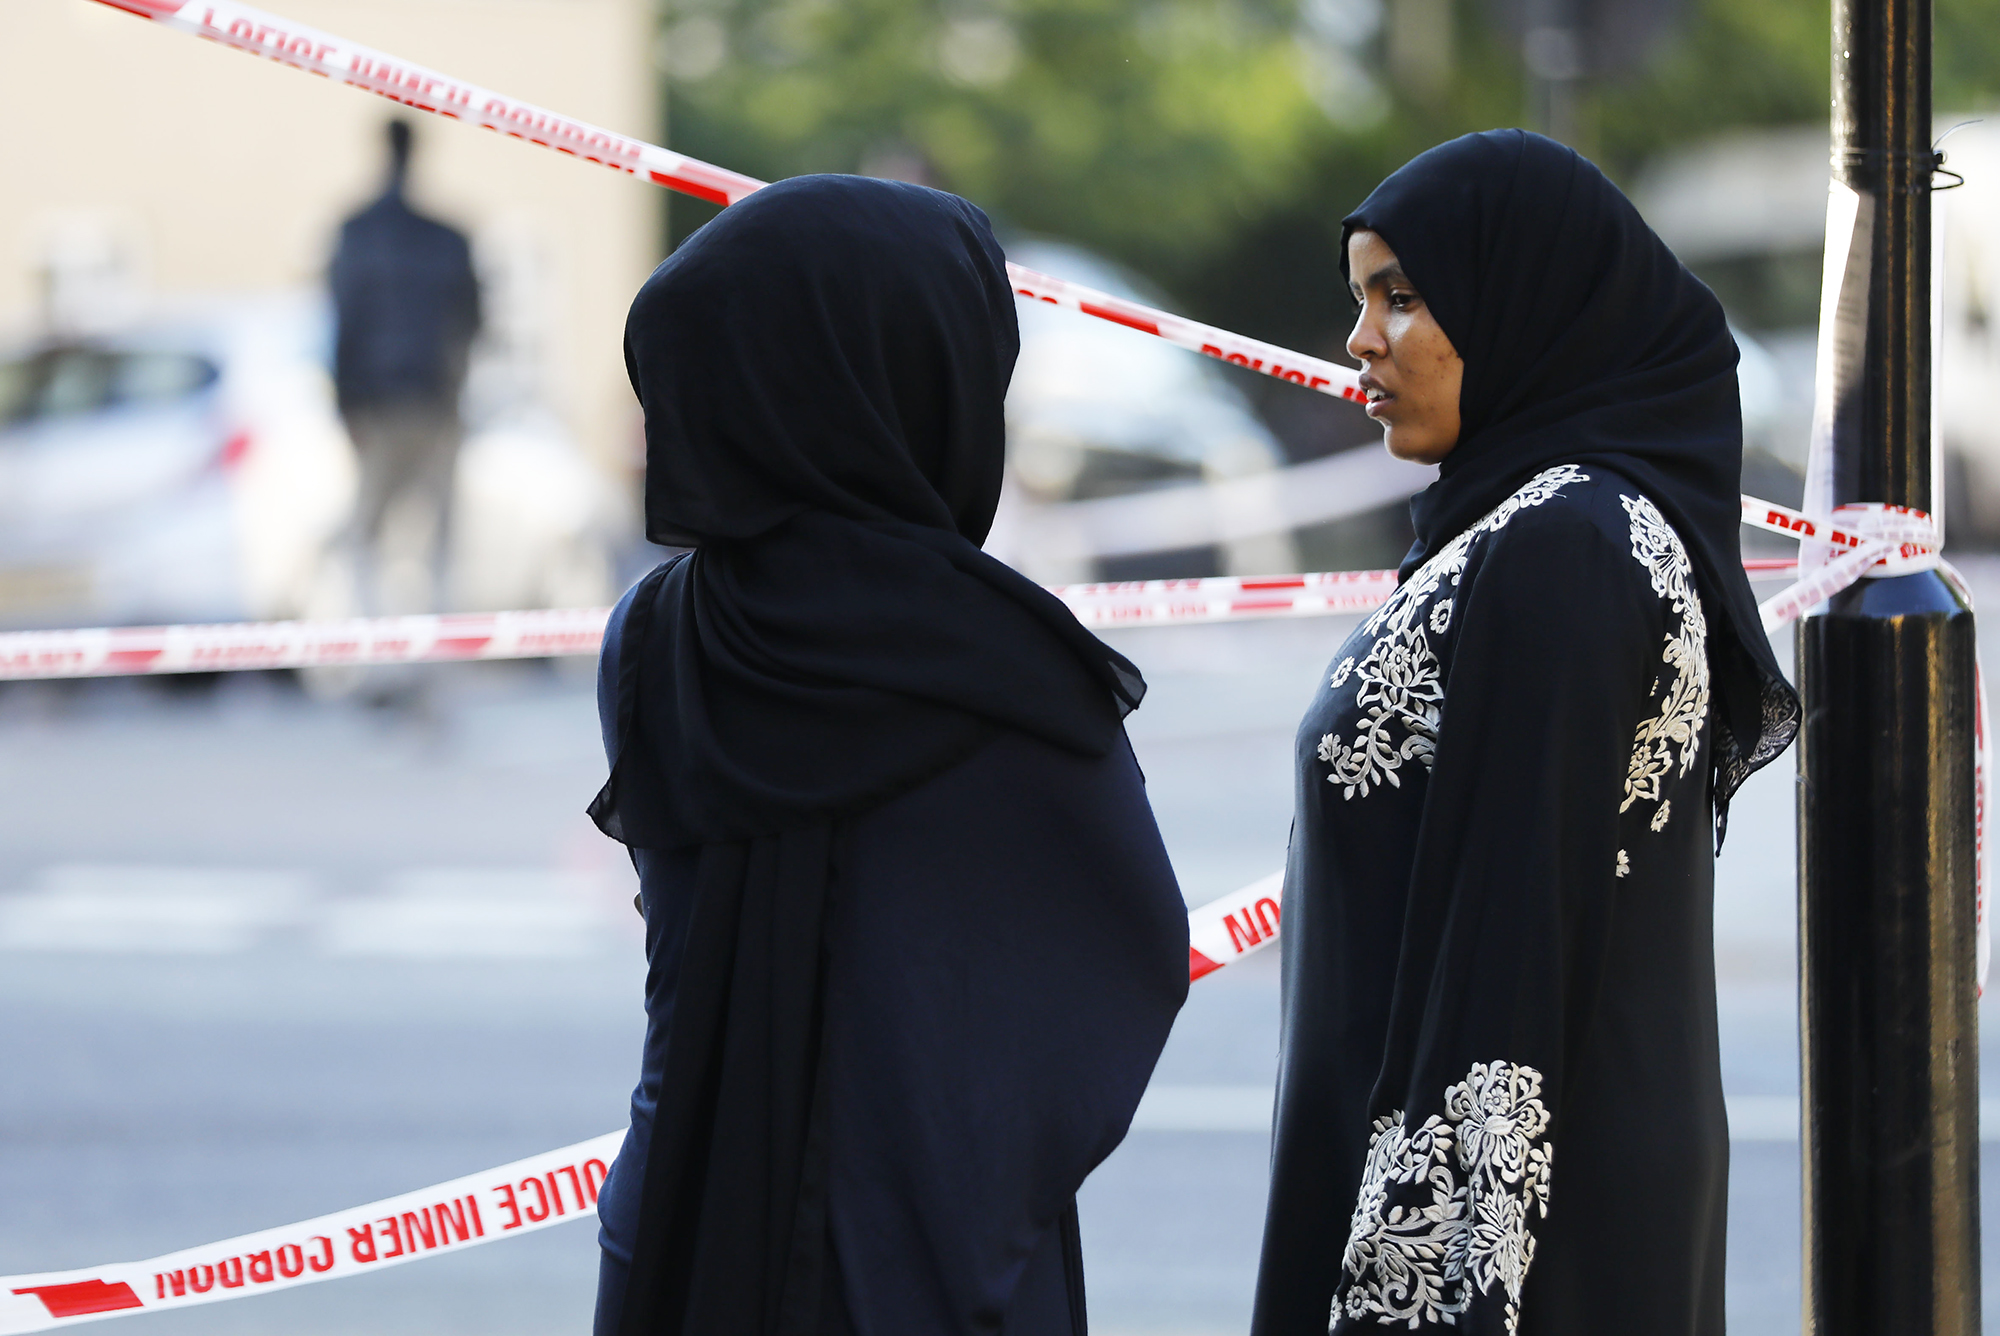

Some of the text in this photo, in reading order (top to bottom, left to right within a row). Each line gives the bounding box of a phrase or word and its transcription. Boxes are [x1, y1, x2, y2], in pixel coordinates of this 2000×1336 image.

[154, 1158, 609, 1299] OLICE INNER CORDON
